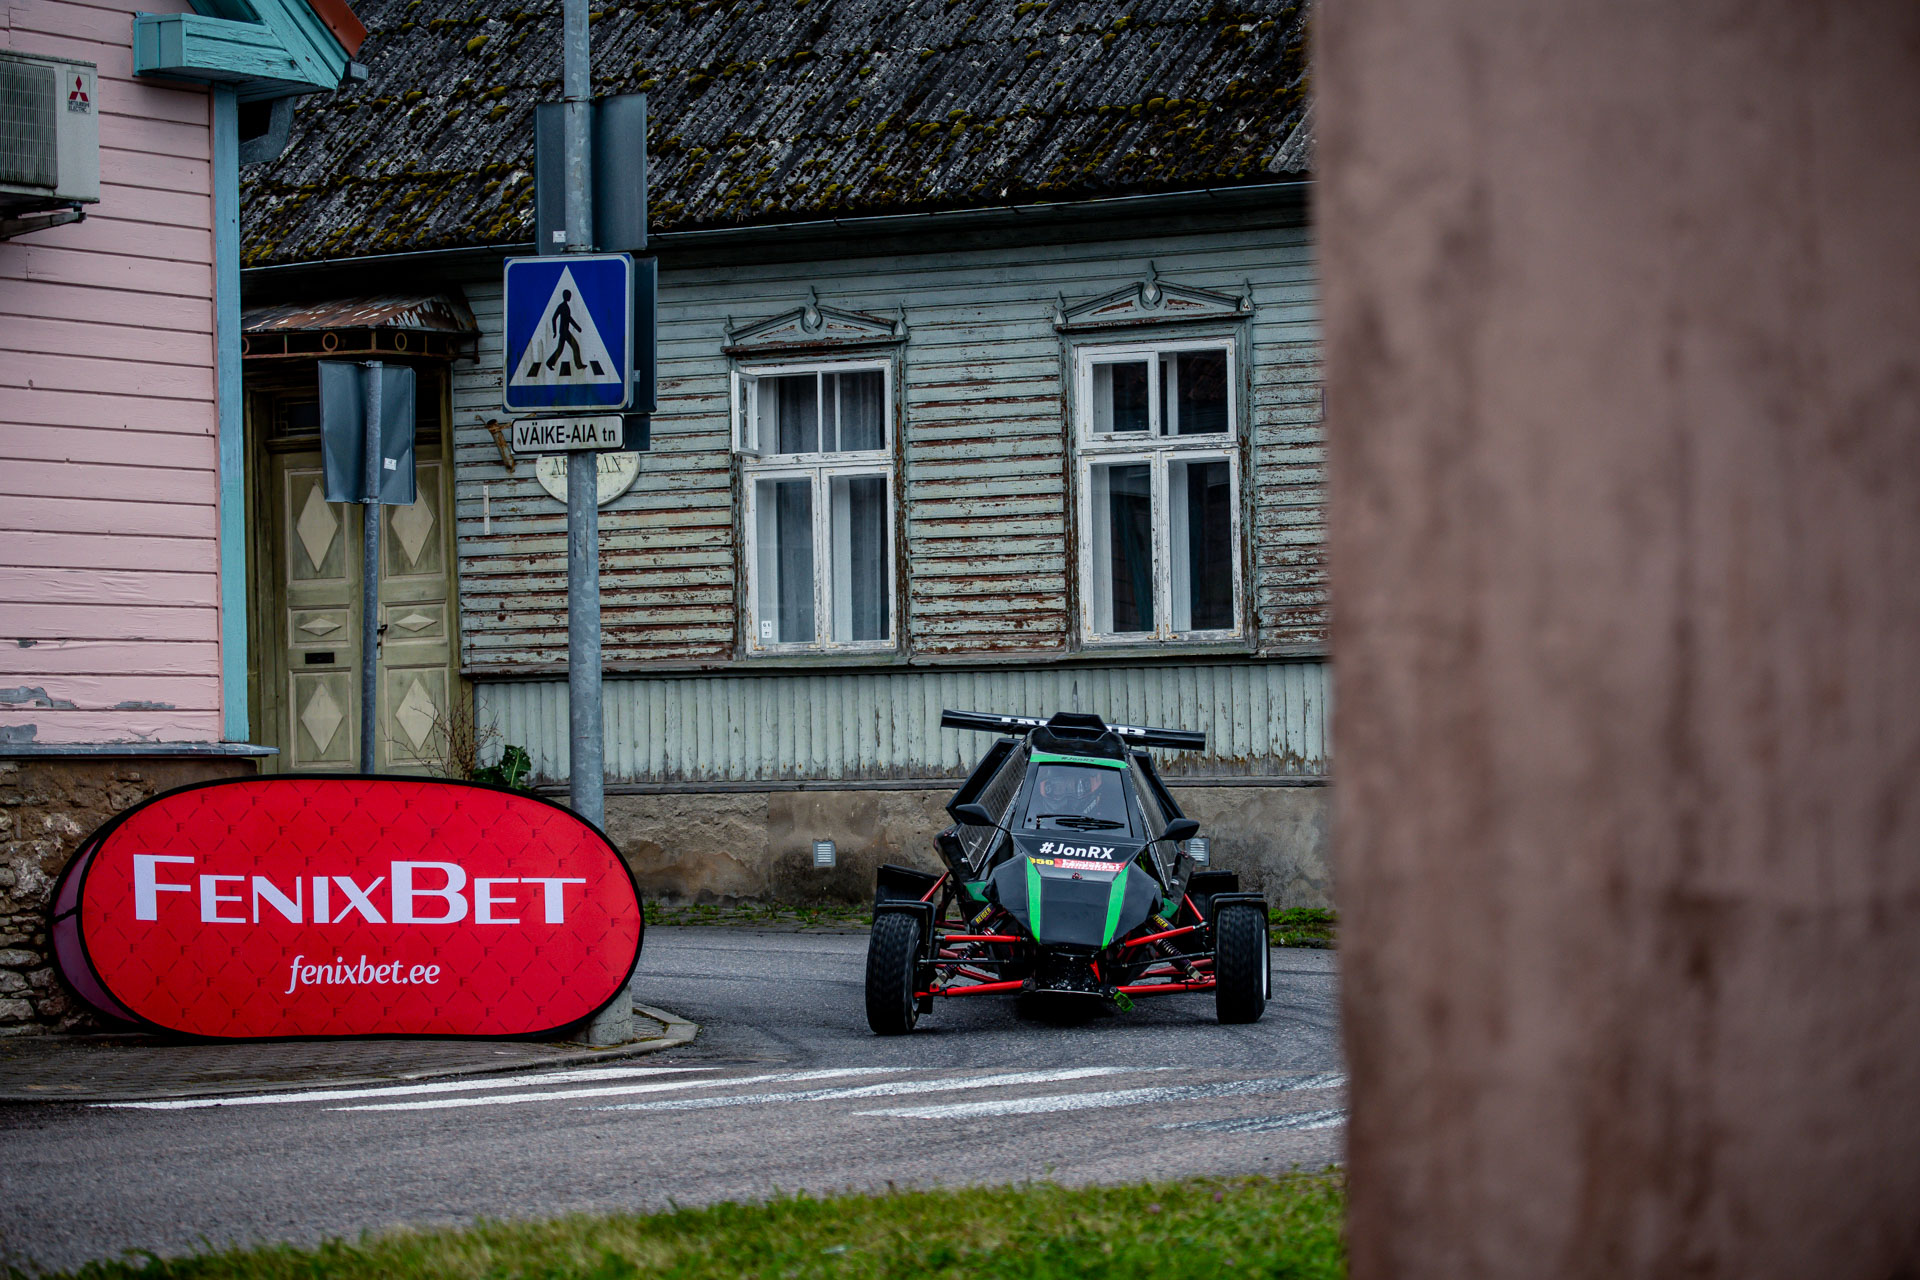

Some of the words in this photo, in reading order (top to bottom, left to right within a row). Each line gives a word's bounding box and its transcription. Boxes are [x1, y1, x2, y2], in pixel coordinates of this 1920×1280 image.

[520, 422, 597, 445] VÄIKE-AIA
[602, 427, 616, 442] tn
[1039, 841, 1115, 860] #JonRX
[284, 954, 441, 994] fenixbet.ee
